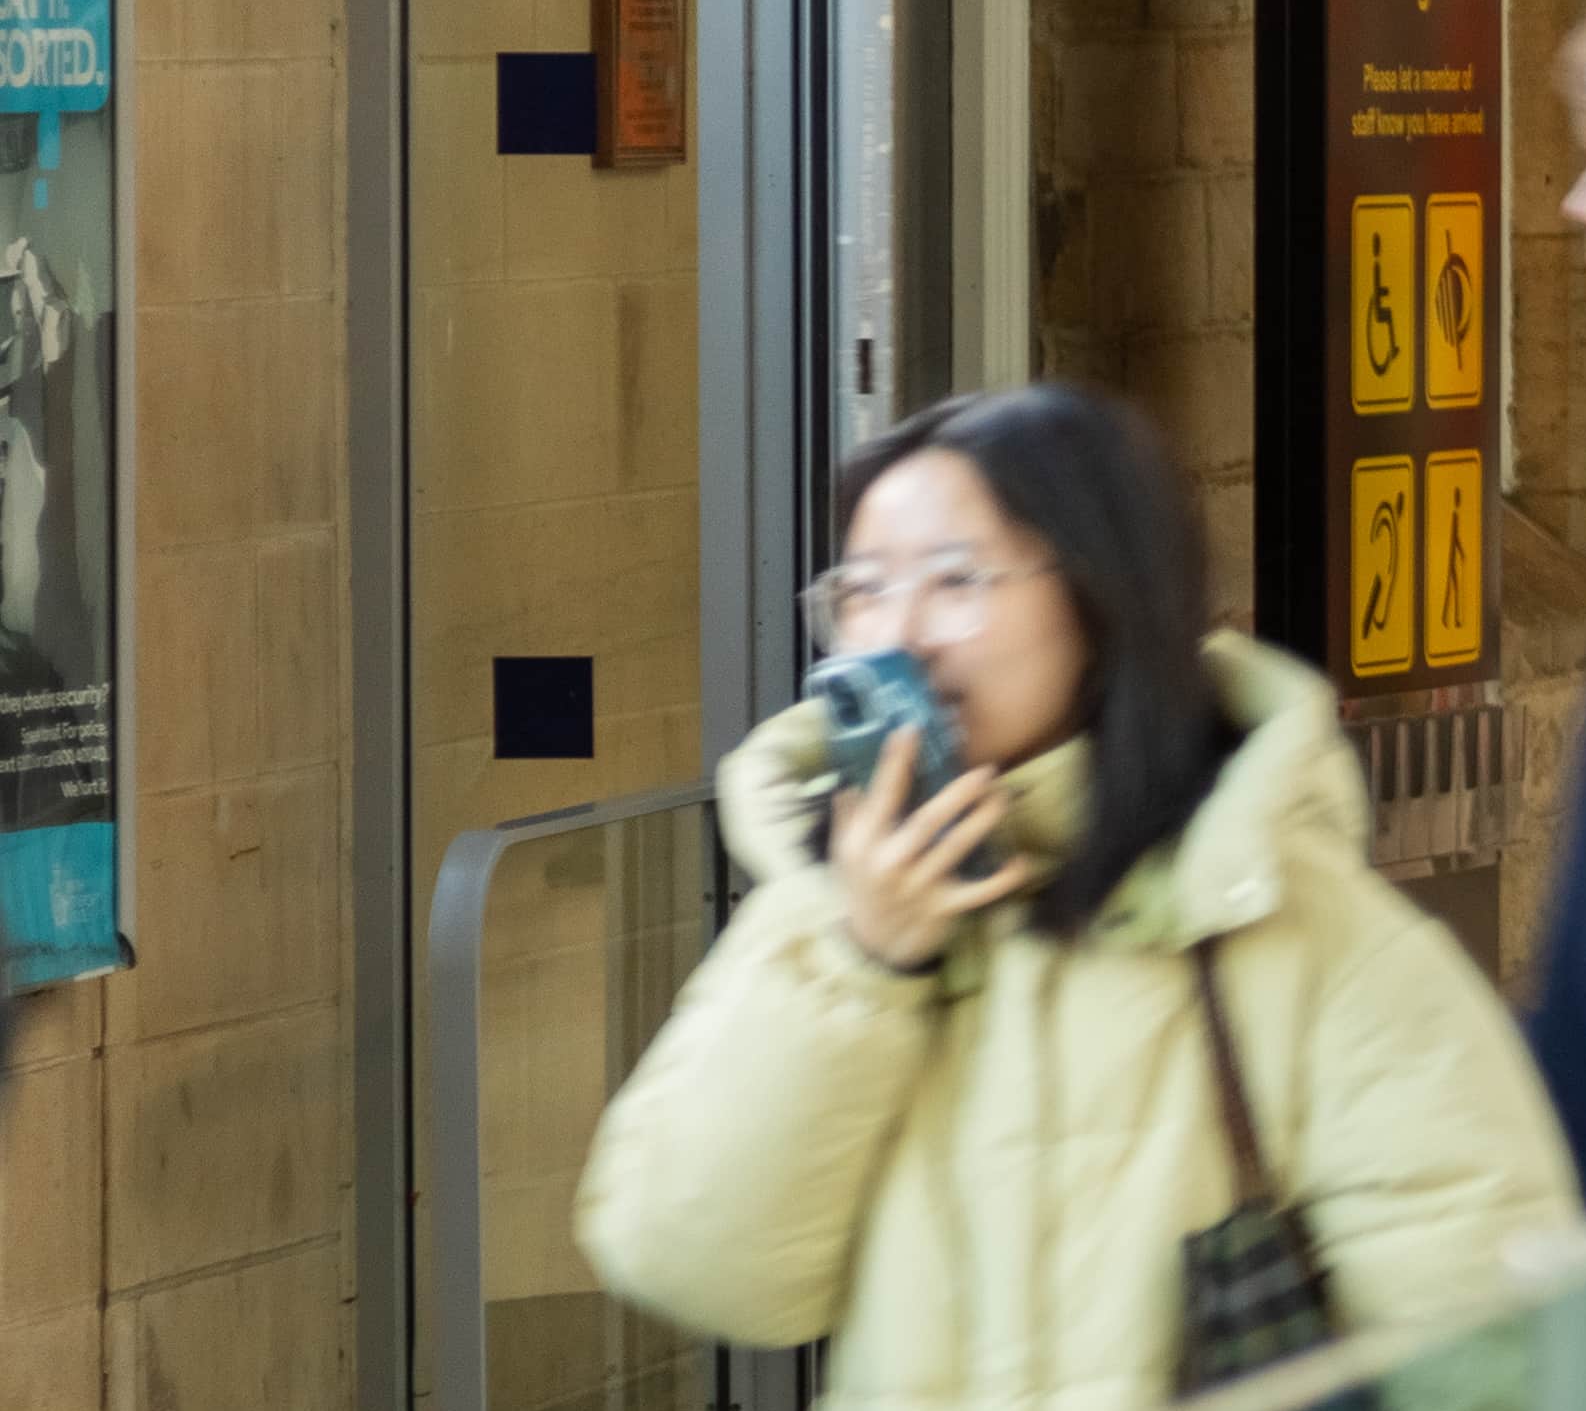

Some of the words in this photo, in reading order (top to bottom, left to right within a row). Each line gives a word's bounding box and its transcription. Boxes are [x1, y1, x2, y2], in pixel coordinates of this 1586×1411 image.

[1363, 62, 1397, 93] Please
[1423, 62, 1460, 92] member
[1351, 106, 1376, 138] staff
[1377, 106, 1404, 136] know
[1405, 112, 1425, 142] you
[1426, 107, 1450, 136] have
